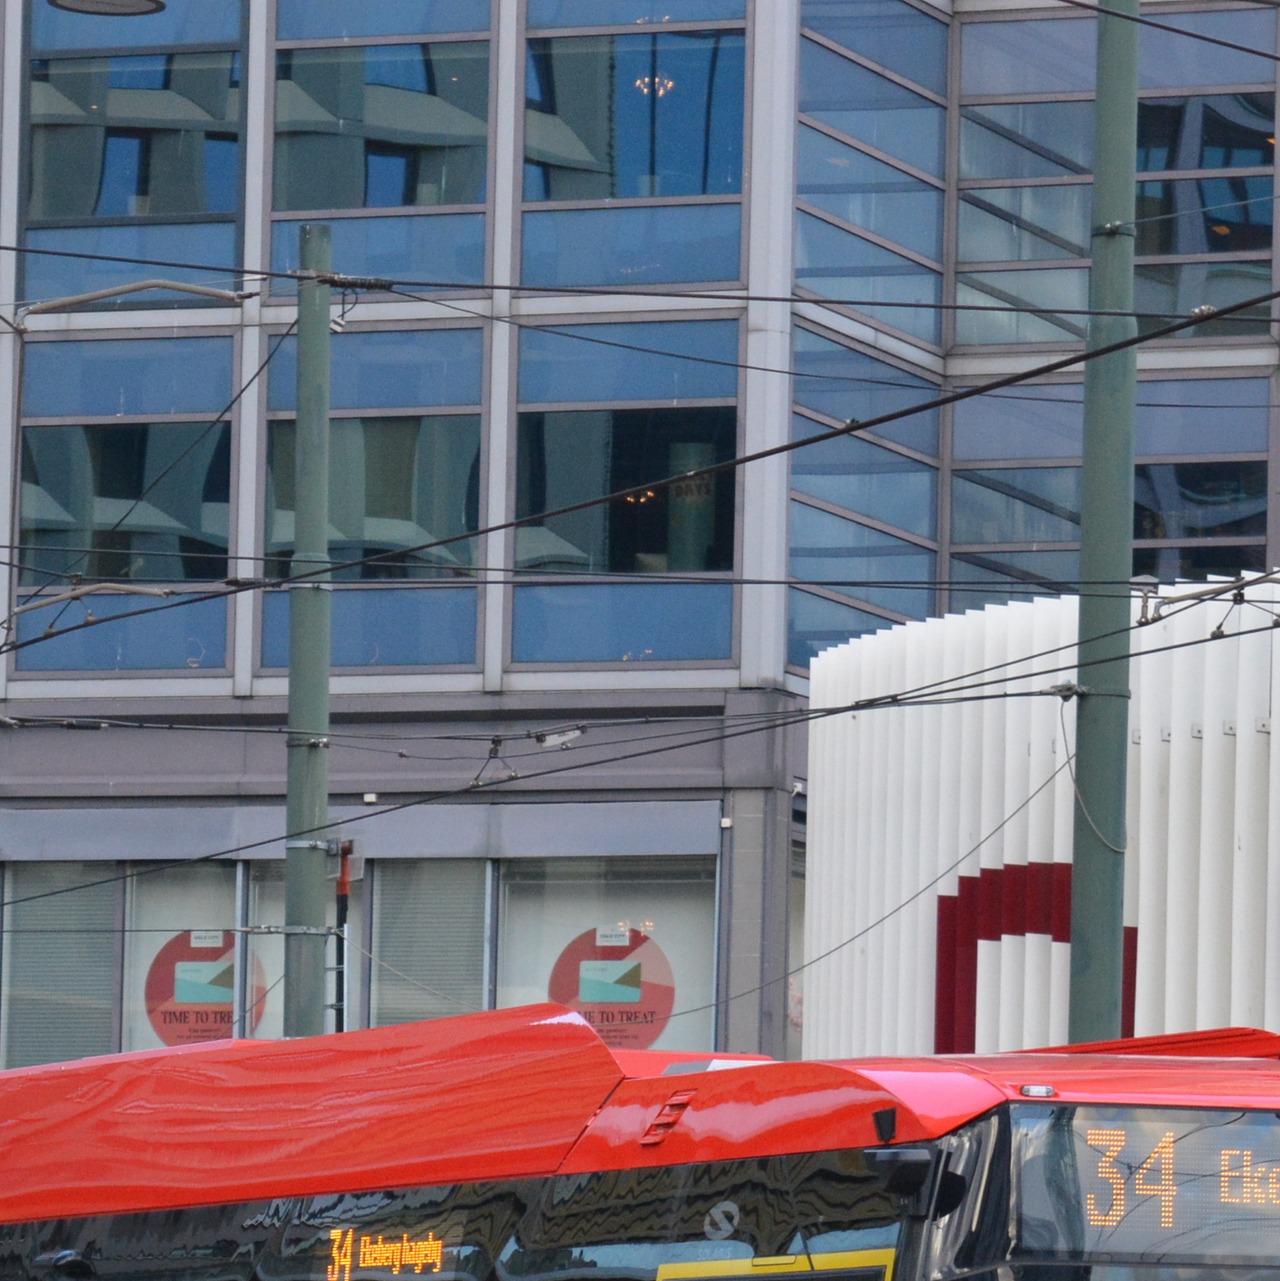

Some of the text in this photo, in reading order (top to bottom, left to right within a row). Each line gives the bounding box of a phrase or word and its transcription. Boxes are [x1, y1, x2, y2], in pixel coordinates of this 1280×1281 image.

[161, 1011, 234, 1025] TIME TO TRE
[598, 1011, 614, 1024] TO
[617, 1011, 656, 1024] TREAT
[1086, 1129, 1178, 1229] 34
